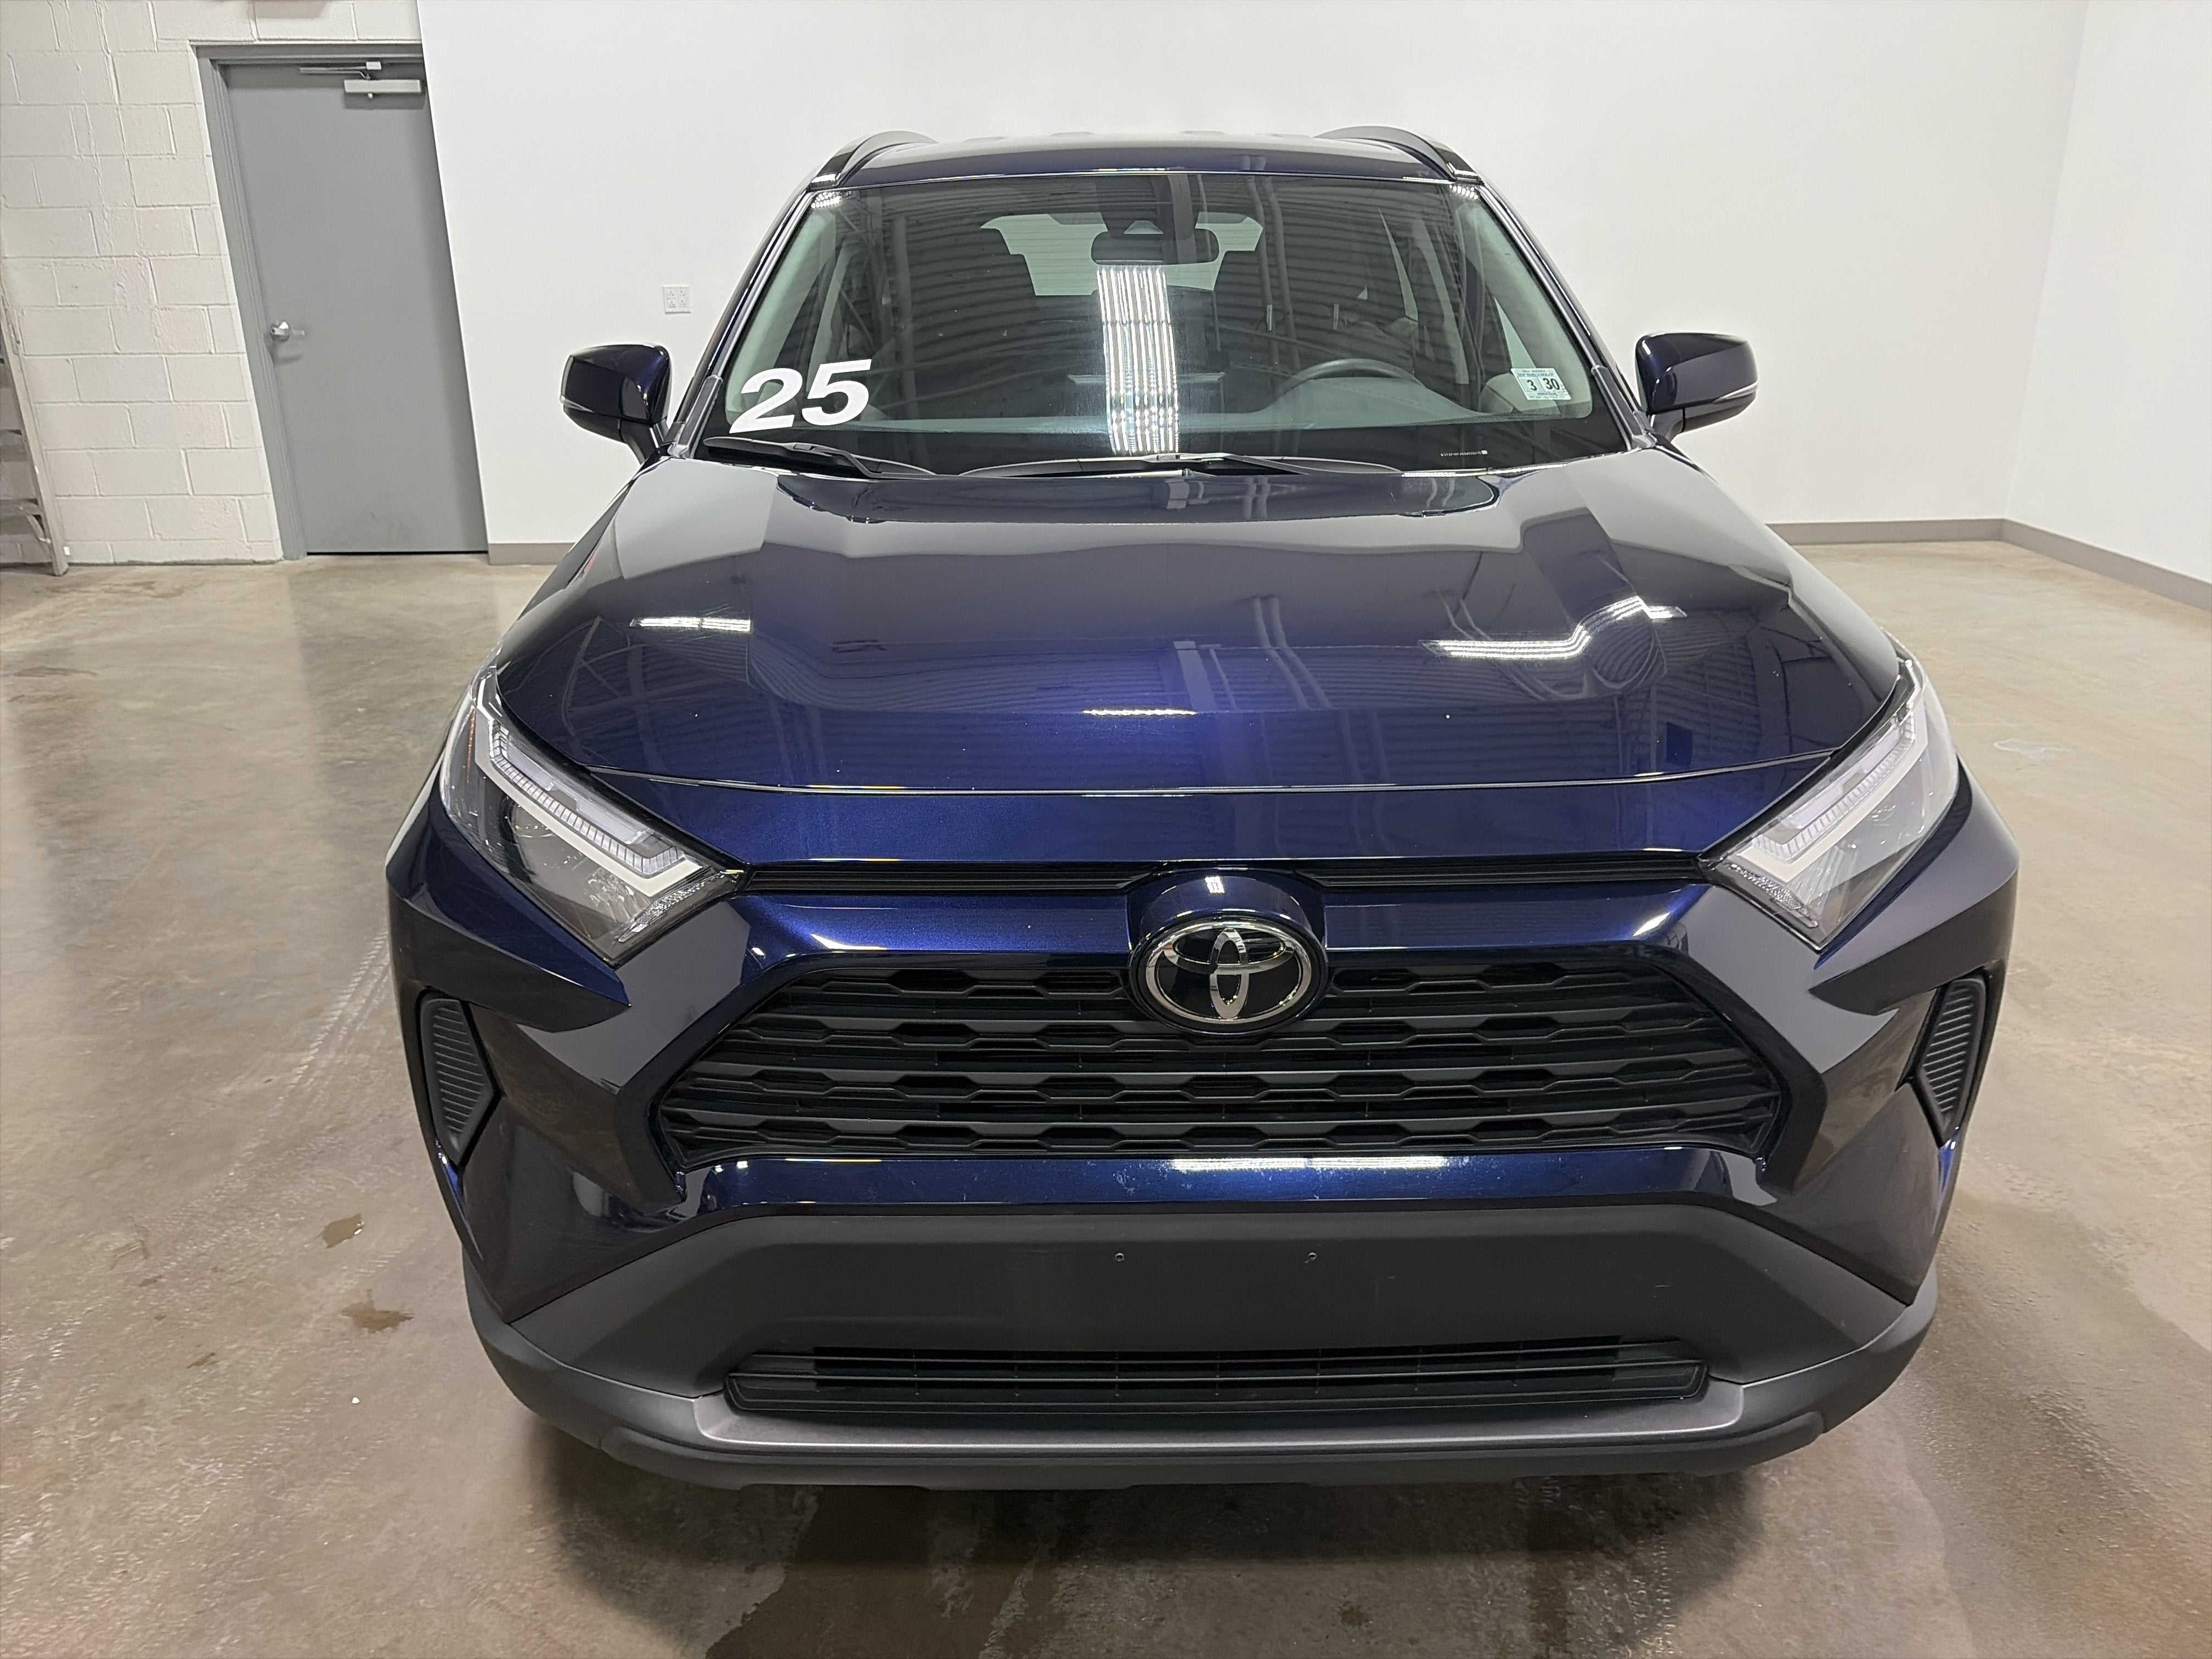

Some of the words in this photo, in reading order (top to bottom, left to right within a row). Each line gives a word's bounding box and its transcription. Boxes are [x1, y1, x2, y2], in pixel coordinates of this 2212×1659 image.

[729, 359, 872, 433] 25
[1526, 379, 1537, 391] 3
[1542, 377, 1560, 390] 30
